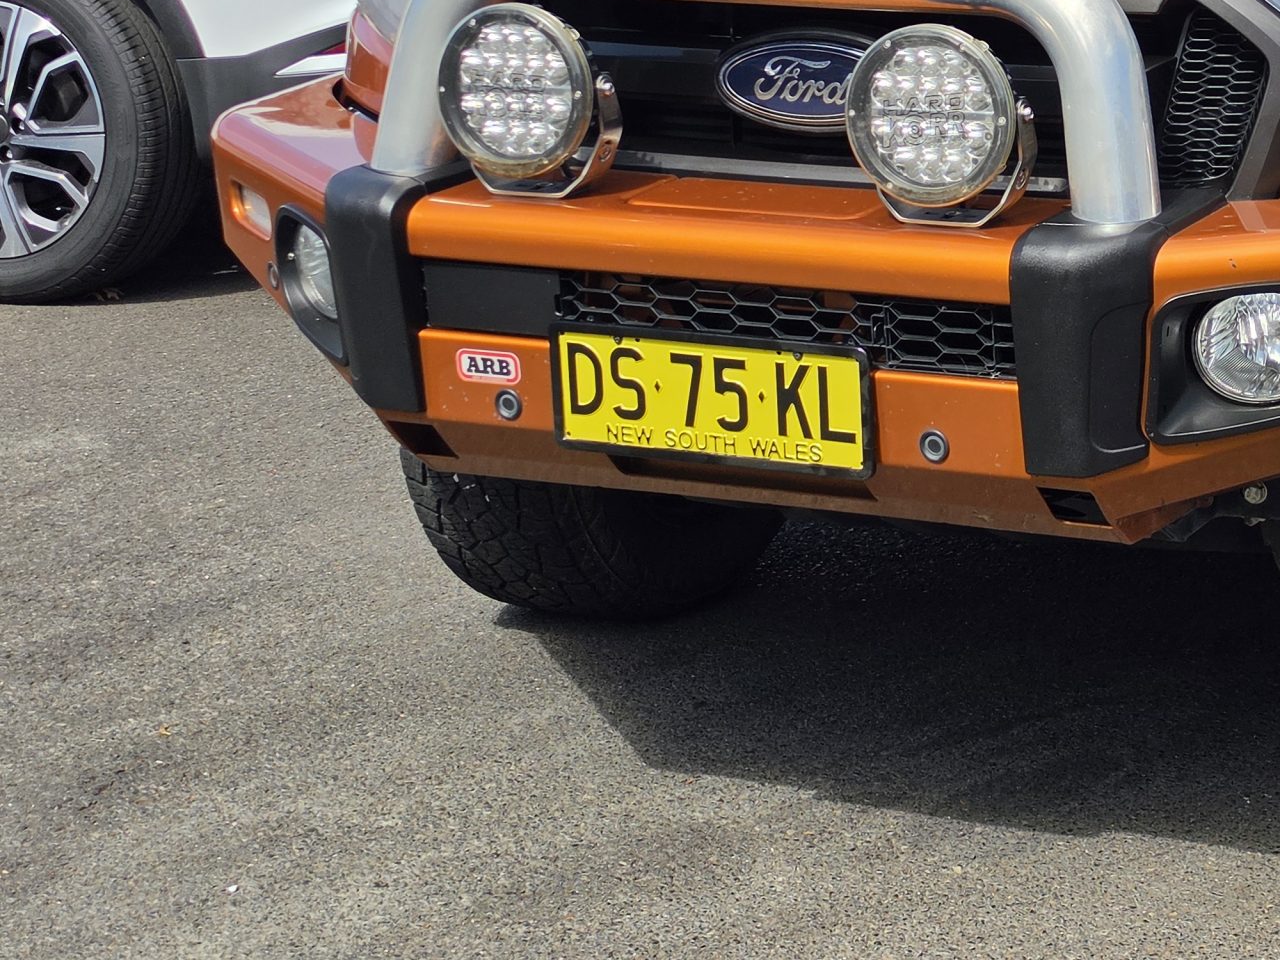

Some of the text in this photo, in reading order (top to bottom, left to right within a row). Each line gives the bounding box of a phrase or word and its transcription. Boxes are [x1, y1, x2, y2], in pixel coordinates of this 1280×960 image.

[753, 55, 849, 106] Ford
[882, 92, 966, 117] HARD
[466, 355, 512, 377] ARB
[606, 423, 823, 463] NEW SOUTH WALES
